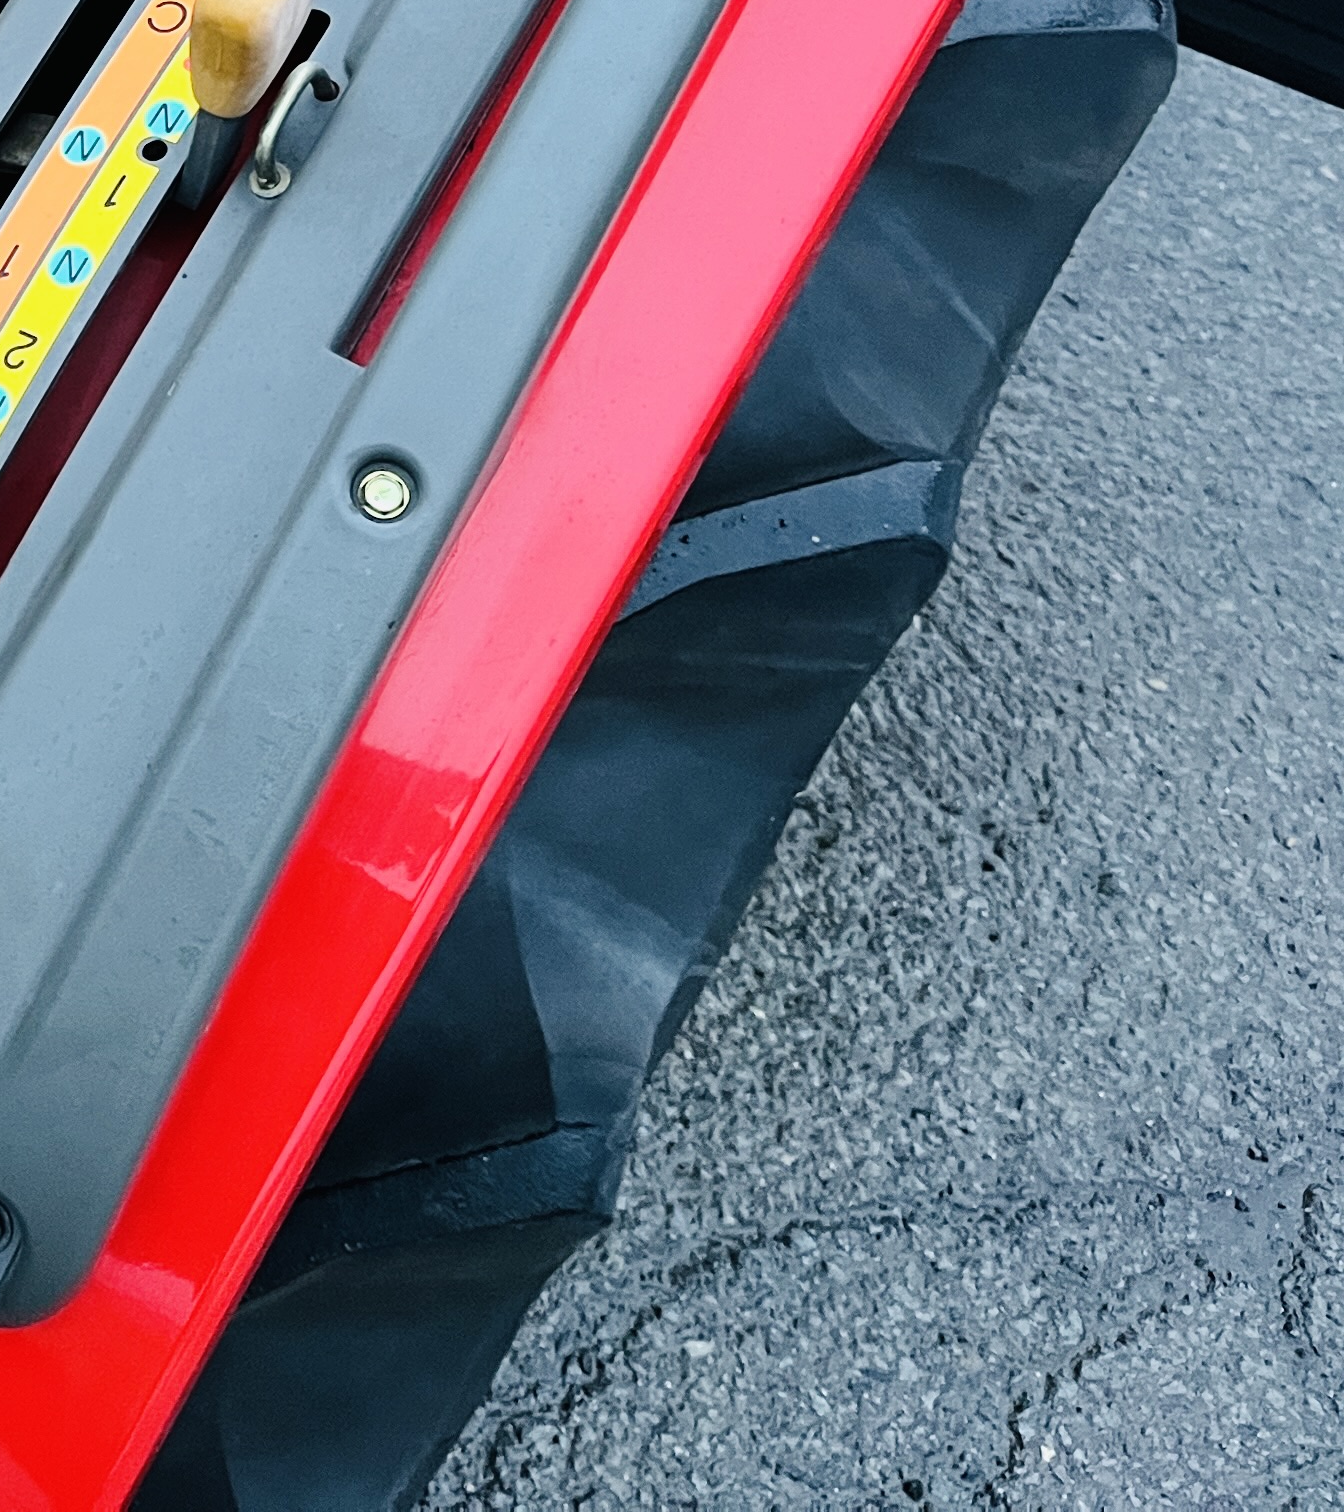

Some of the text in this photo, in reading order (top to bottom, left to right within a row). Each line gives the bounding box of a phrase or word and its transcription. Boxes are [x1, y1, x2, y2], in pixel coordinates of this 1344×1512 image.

[147, 0, 188, 33] C
[148, 102, 186, 134] N
[64, 130, 103, 162] N
[104, 175, 127, 207] 1
[52, 249, 89, 283] N
[3, 330, 38, 370] 2
